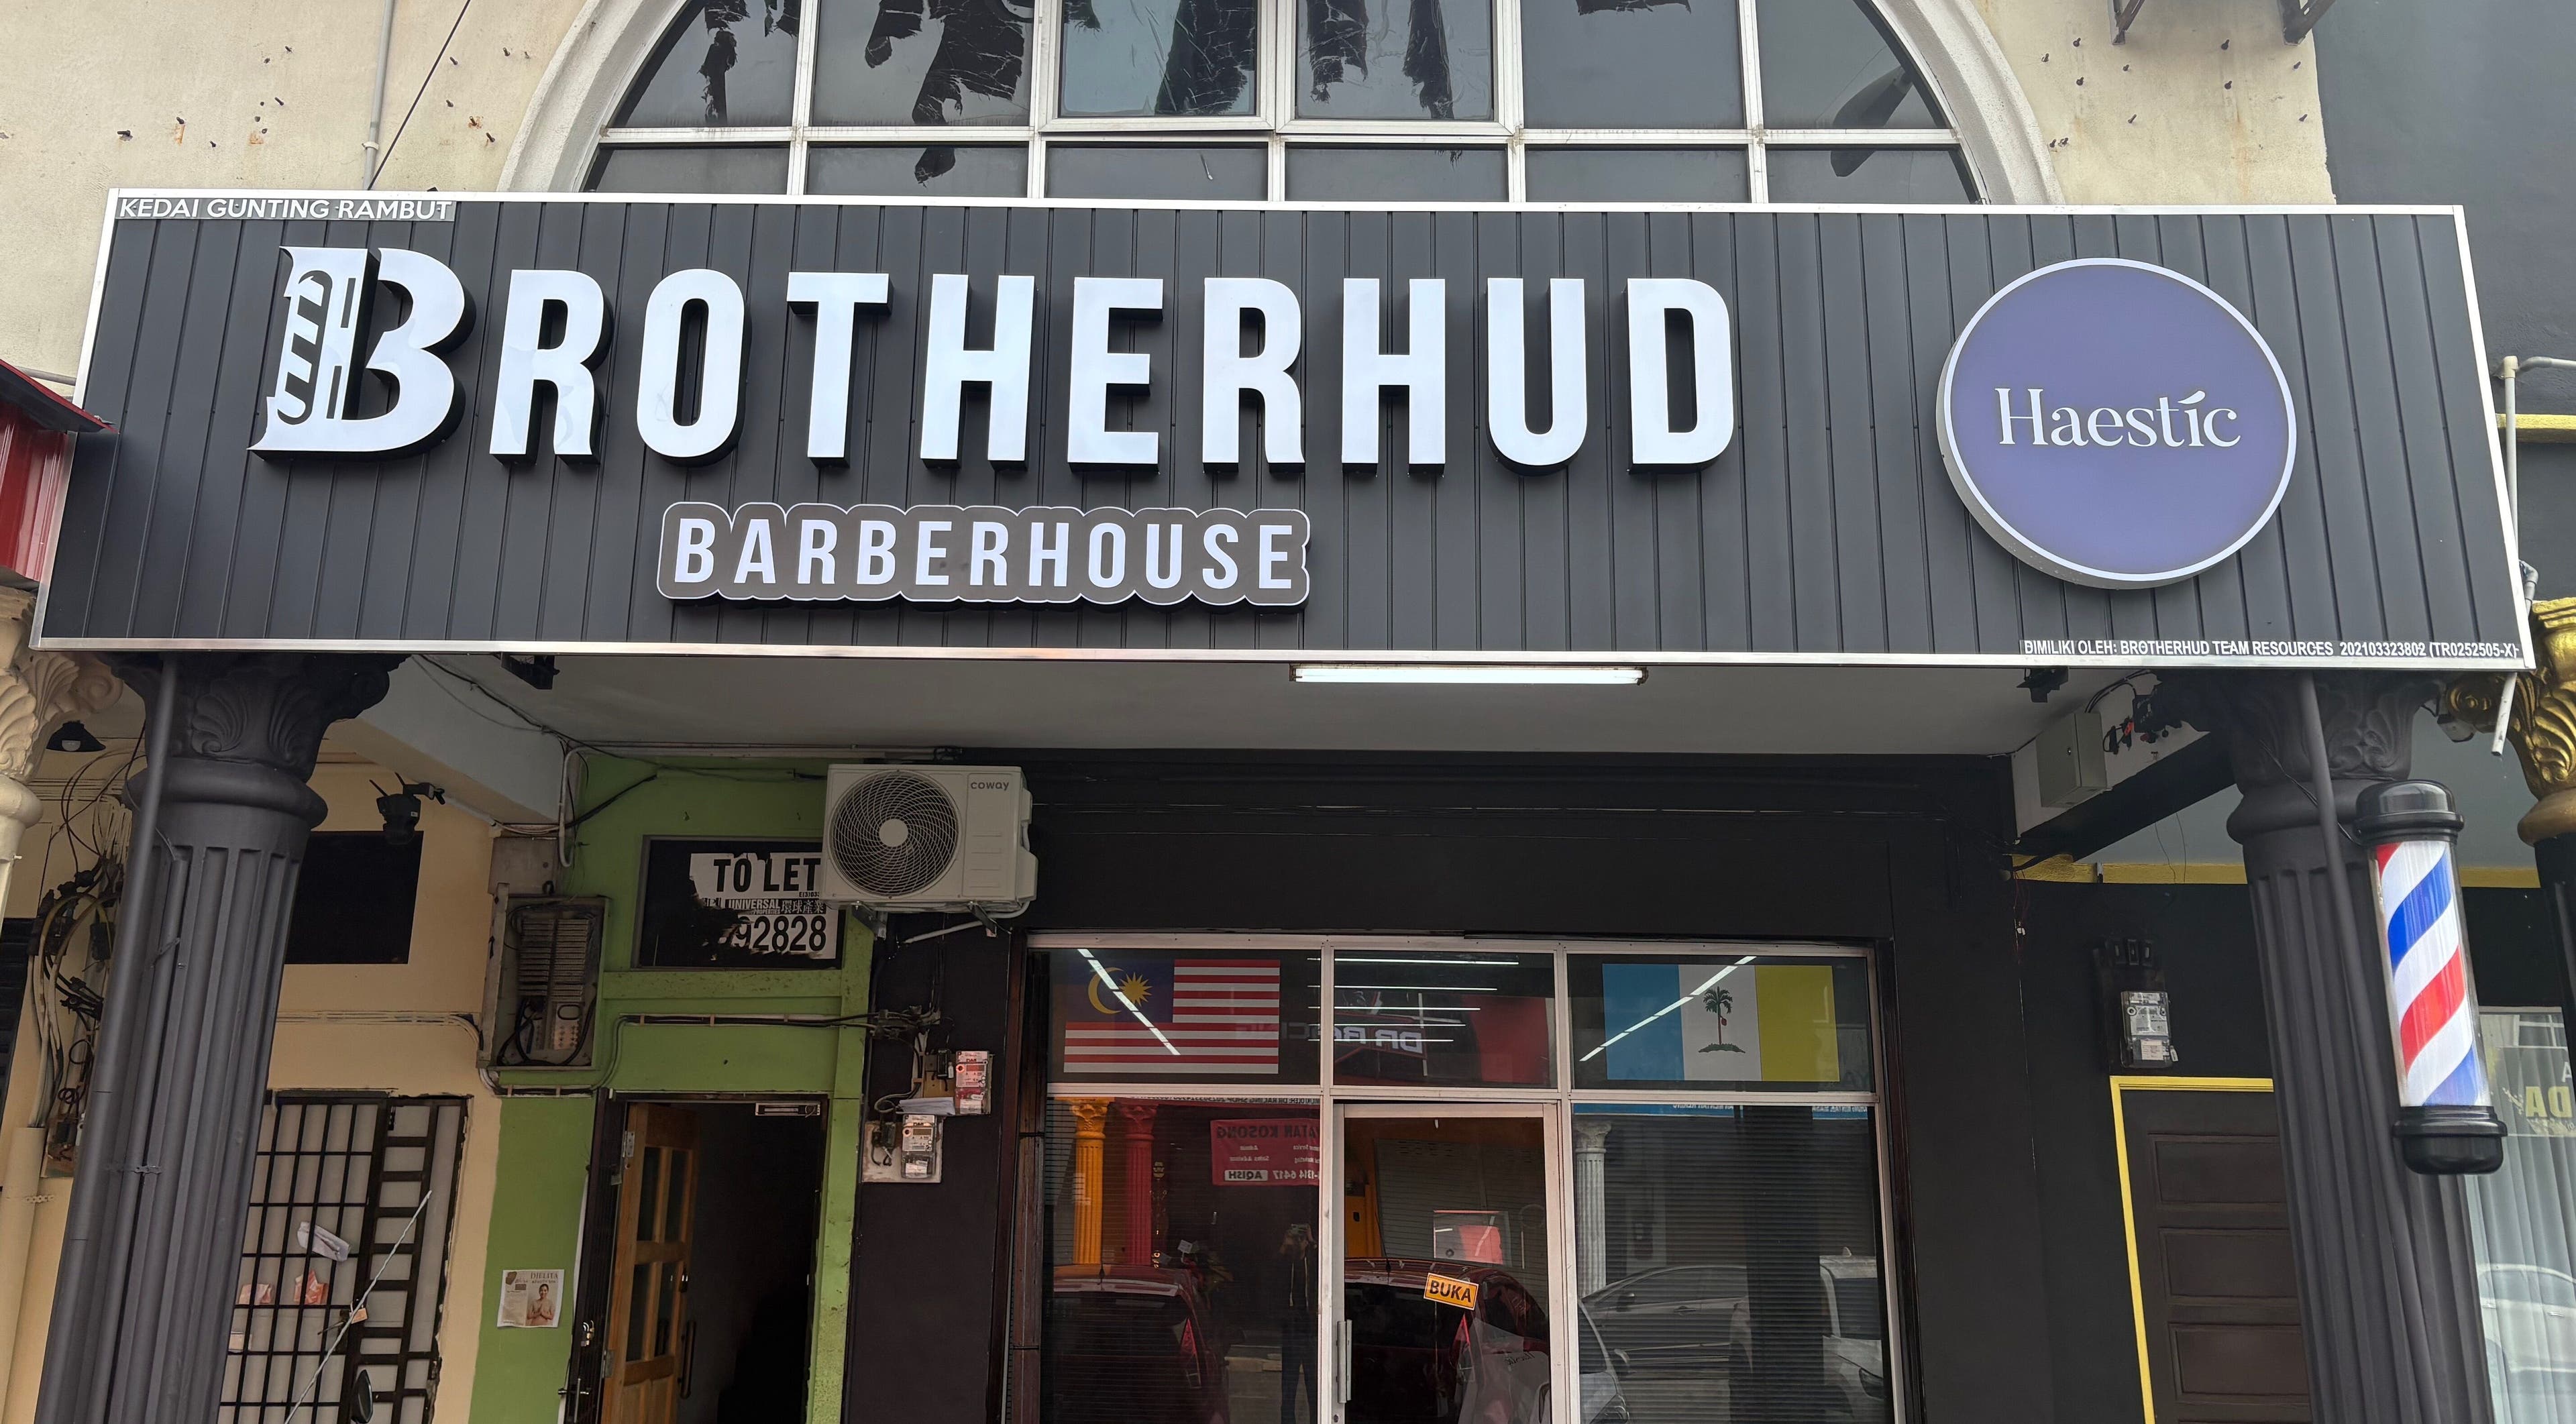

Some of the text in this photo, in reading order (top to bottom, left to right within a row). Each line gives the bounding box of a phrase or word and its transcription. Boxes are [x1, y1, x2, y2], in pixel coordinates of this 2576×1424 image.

[119, 199, 453, 220] KEDAI GUNTING RAMBUT
[247, 245, 1735, 466] BROTHERHUD
[674, 518, 1293, 590] BARBERHOUSE
[2078, 640, 2117, 655] OLEH:
[2121, 640, 2210, 655] BROTHERHUD
[2212, 641, 2249, 655] TEAM
[2253, 641, 2334, 656] RESOURCES
[2339, 641, 2426, 656] 202103323802
[2429, 643, 2517, 658] (TR0252505-X)
[970, 781, 1010, 791] coway
[713, 857, 821, 893] TO LET
[729, 899, 781, 910] UNIVERSAL
[1429, 1279, 1472, 1303] BUKA
